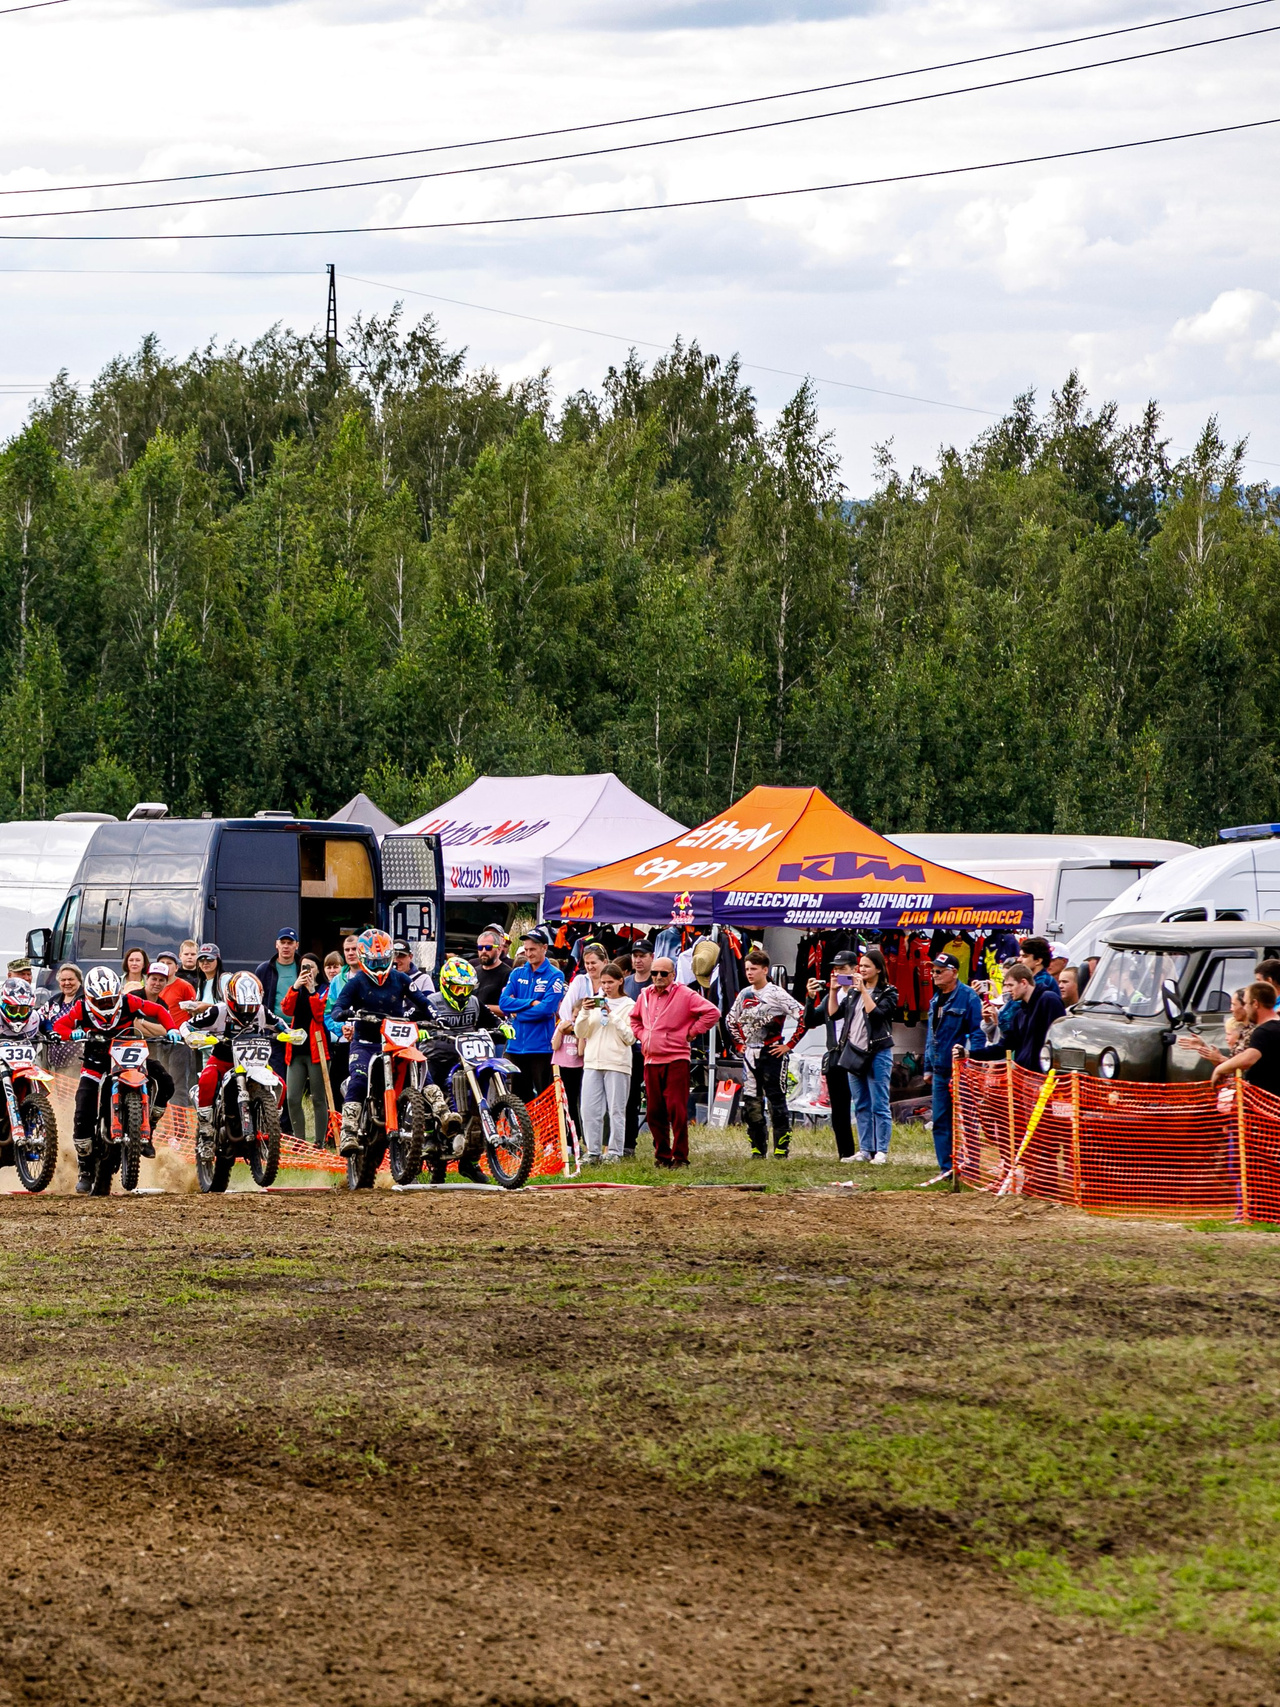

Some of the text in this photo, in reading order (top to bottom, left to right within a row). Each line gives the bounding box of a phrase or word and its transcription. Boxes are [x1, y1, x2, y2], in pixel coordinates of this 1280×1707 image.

[776, 852, 926, 883] KTM
[450, 865, 510, 888] Uktus Moto
[561, 892, 594, 918] KTM
[724, 891, 934, 909] АКСЕССУАРЫ ЗАПЧАСТИ
[783, 910, 881, 925] ЭКИПИРОВКА
[897, 910, 928, 927] для
[391, 1025, 411, 1037] 59
[5, 1048, 33, 1061] 334
[121, 1047, 142, 1062] 6
[236, 1047, 270, 1061] 776
